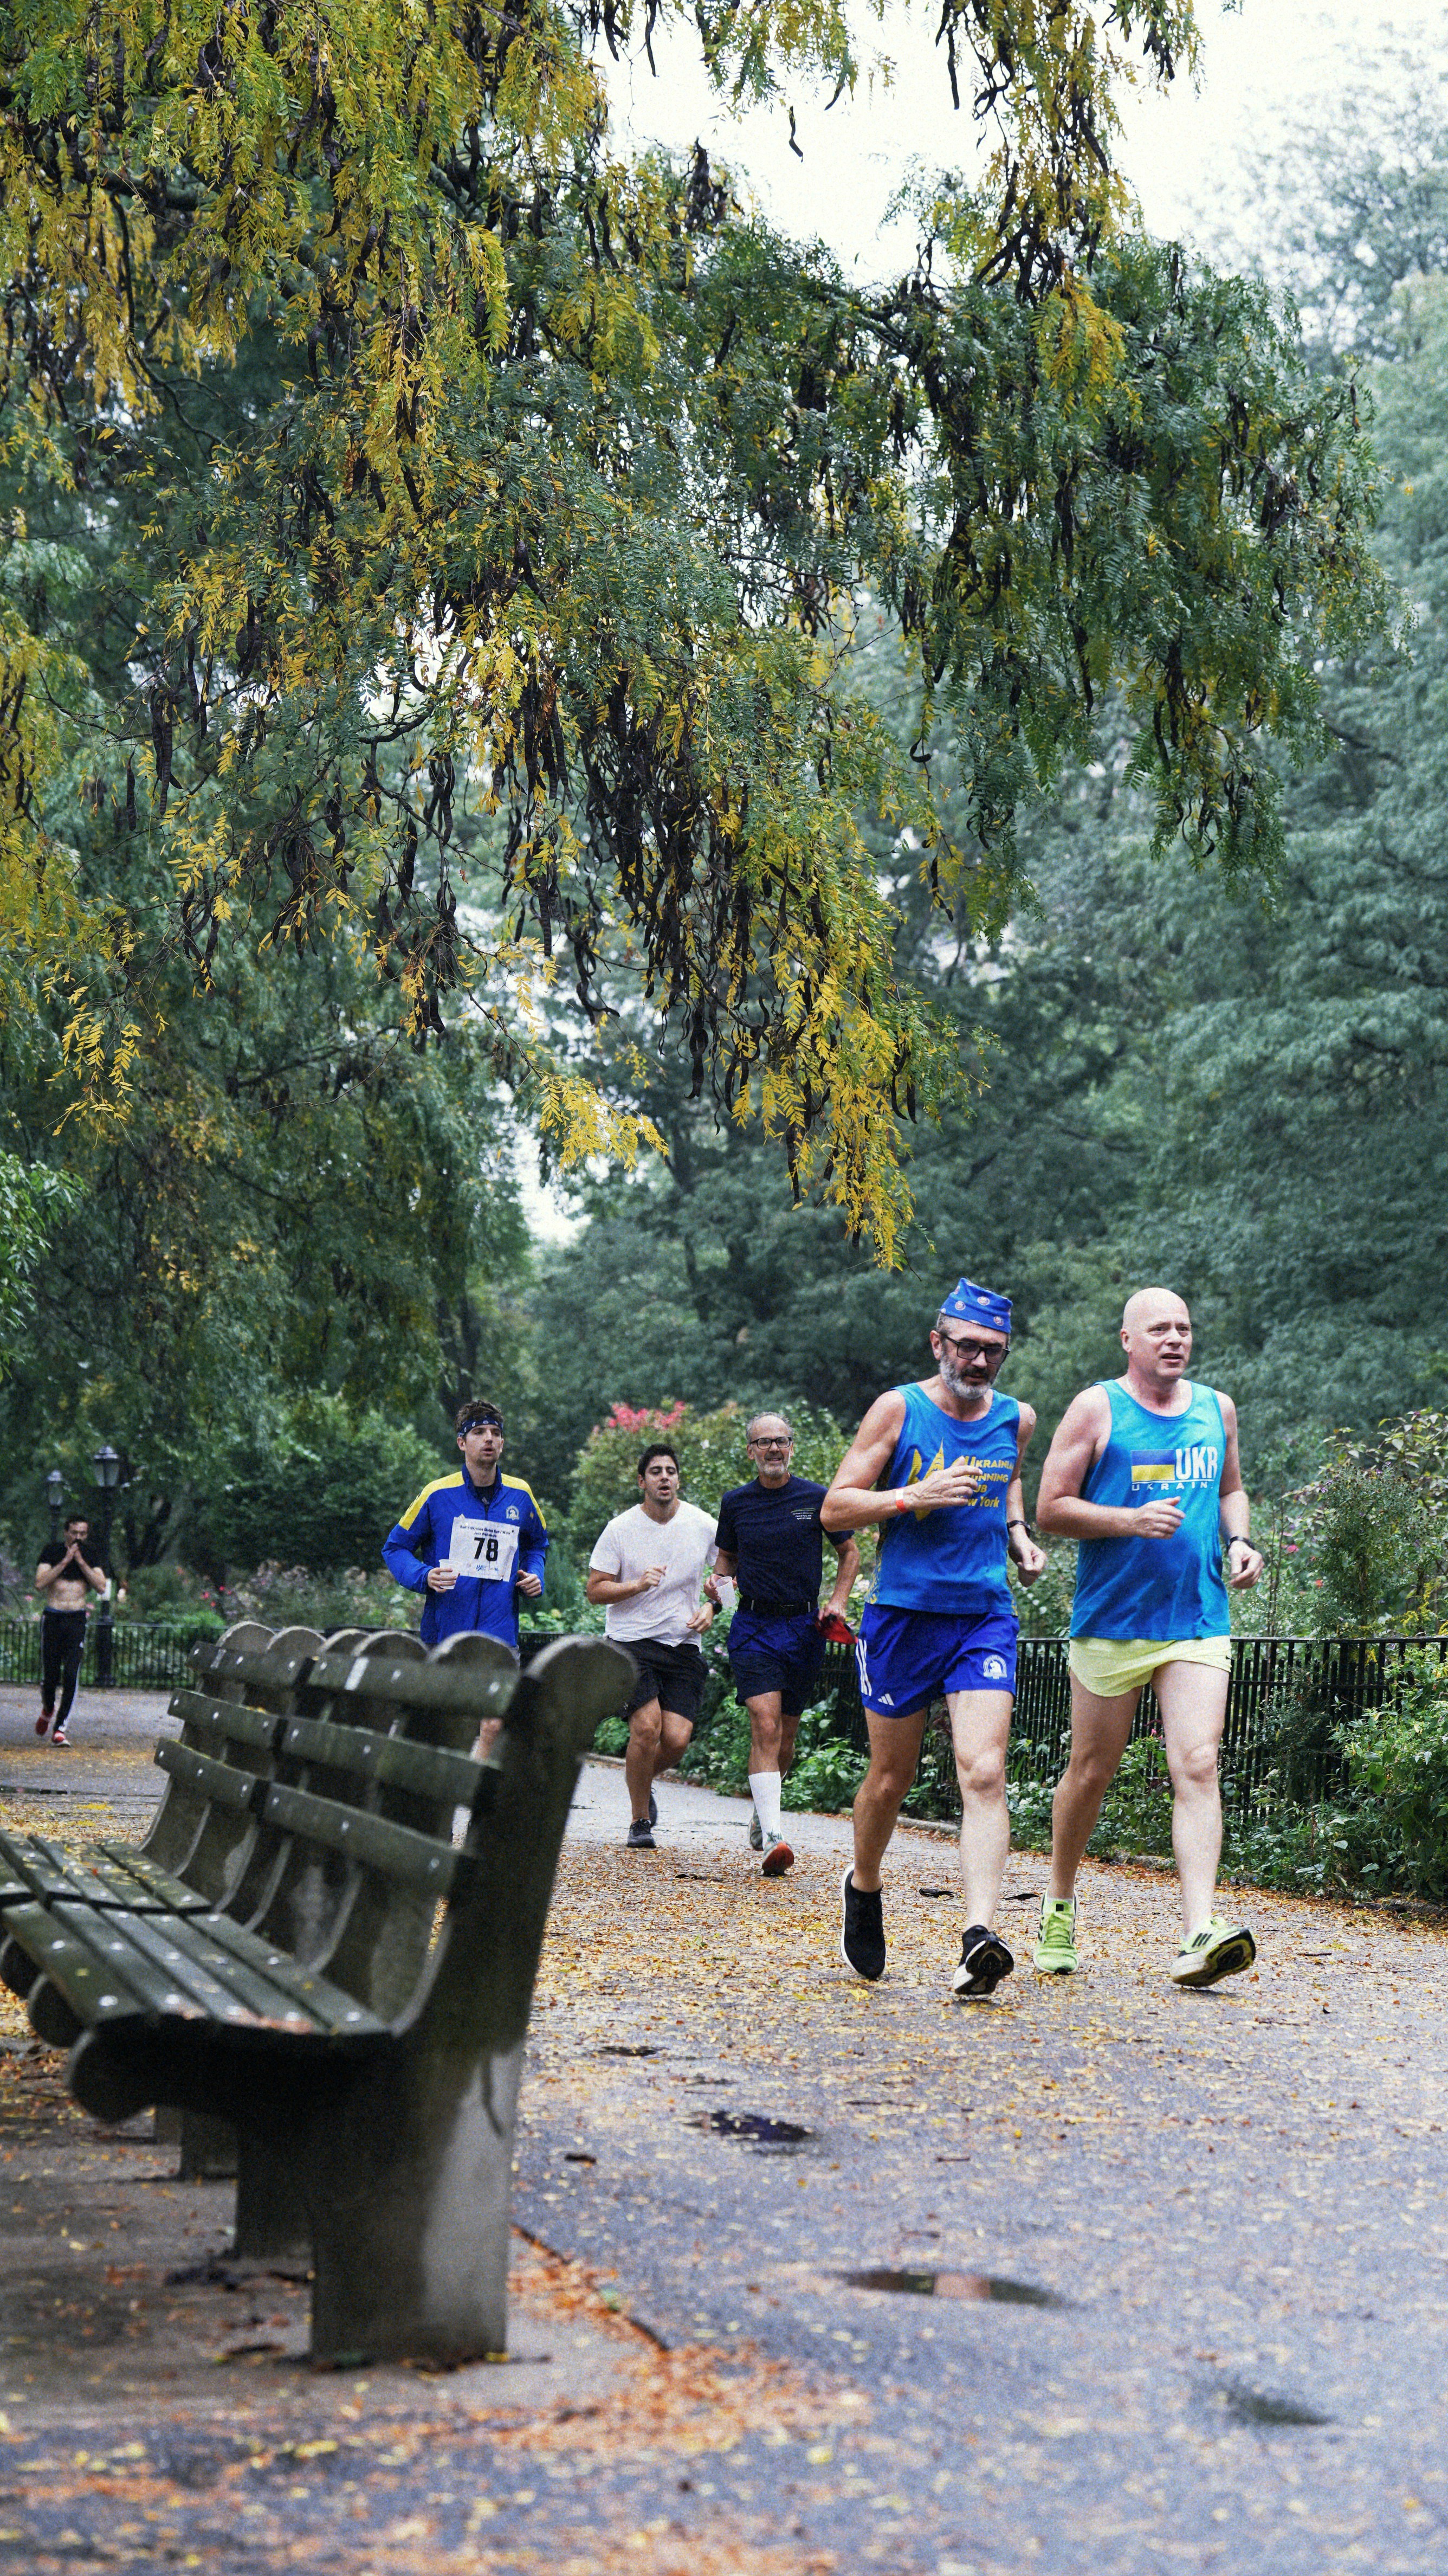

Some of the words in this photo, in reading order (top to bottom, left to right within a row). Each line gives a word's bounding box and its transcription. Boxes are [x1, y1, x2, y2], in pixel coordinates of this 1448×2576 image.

[1175, 1446, 1218, 1480] UKR
[965, 1473, 1009, 1483] UNNING
[1132, 1482, 1213, 1491] UKRAIN
[980, 1496, 999, 1507] York
[474, 1537, 498, 1561] 78
